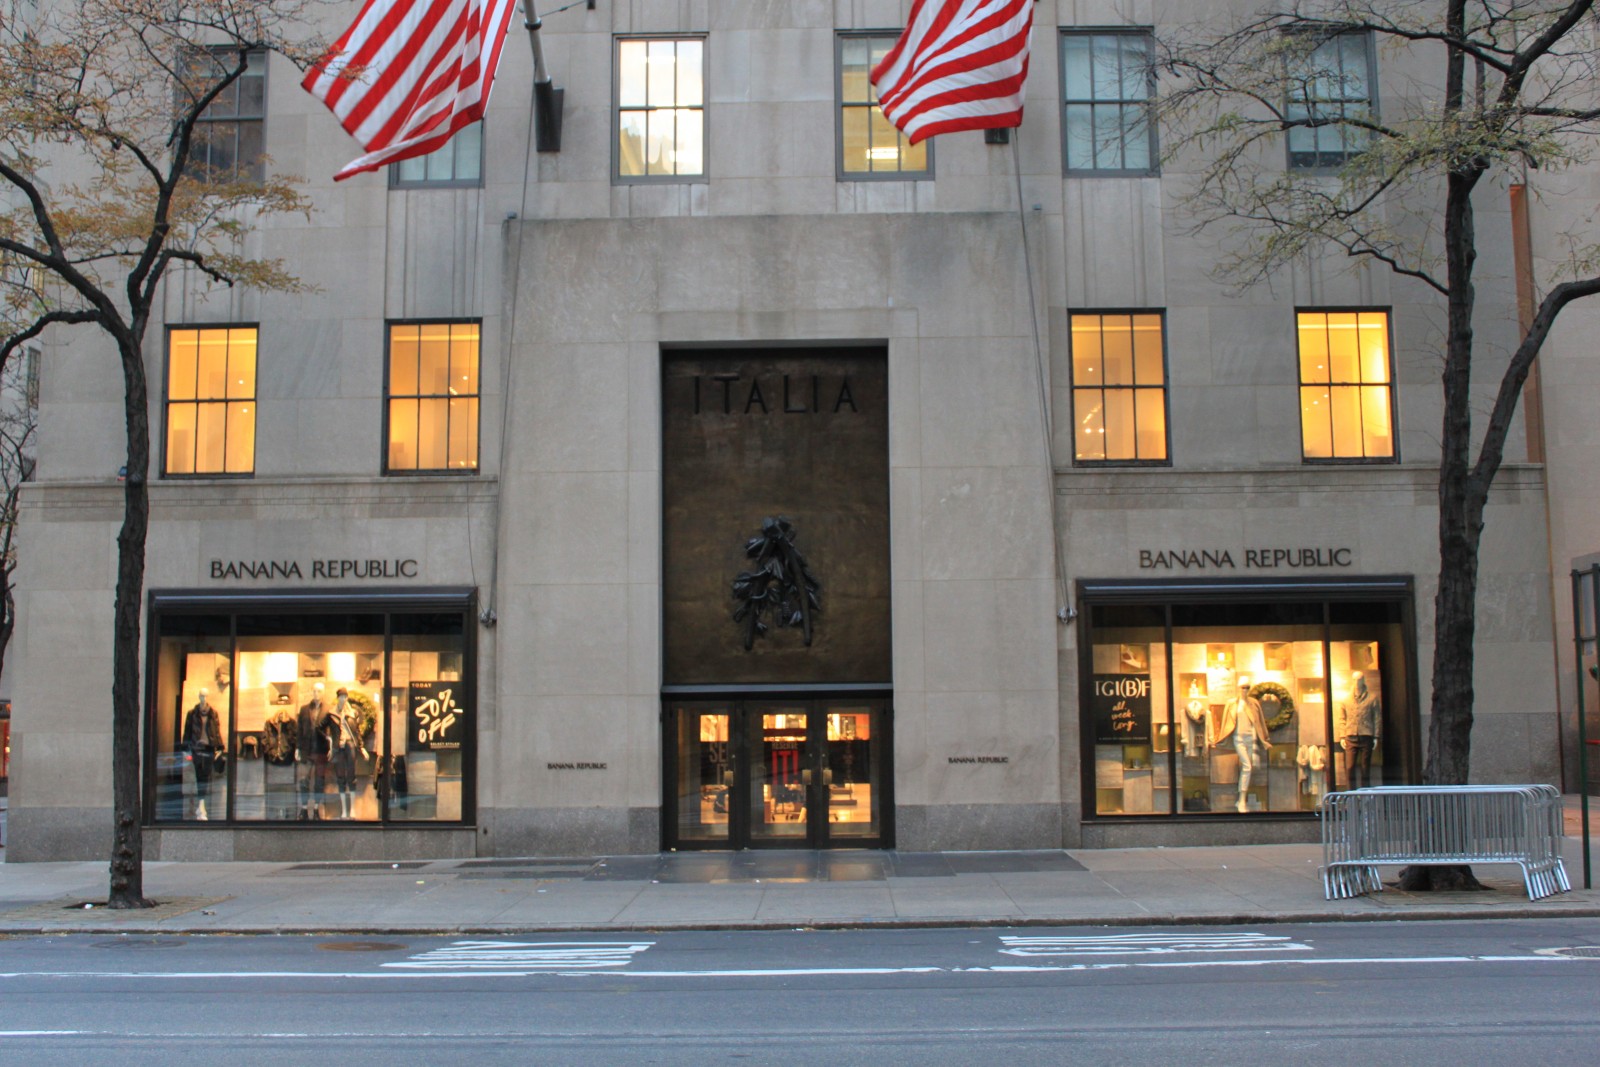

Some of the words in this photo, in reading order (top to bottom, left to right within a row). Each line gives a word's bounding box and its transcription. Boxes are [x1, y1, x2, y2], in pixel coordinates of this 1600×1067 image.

[694, 374, 858, 415] ITALIA
[210, 560, 303, 579] BANANA
[312, 559, 418, 579] REPUBLIC
[1138, 549, 1235, 569] BANANA
[1245, 547, 1352, 568] REPUBLIC
[415, 688, 456, 725] 50%
[418, 713, 456, 744] OFF
[709, 743, 729, 763] SE
[771, 749, 799, 785] IT!
